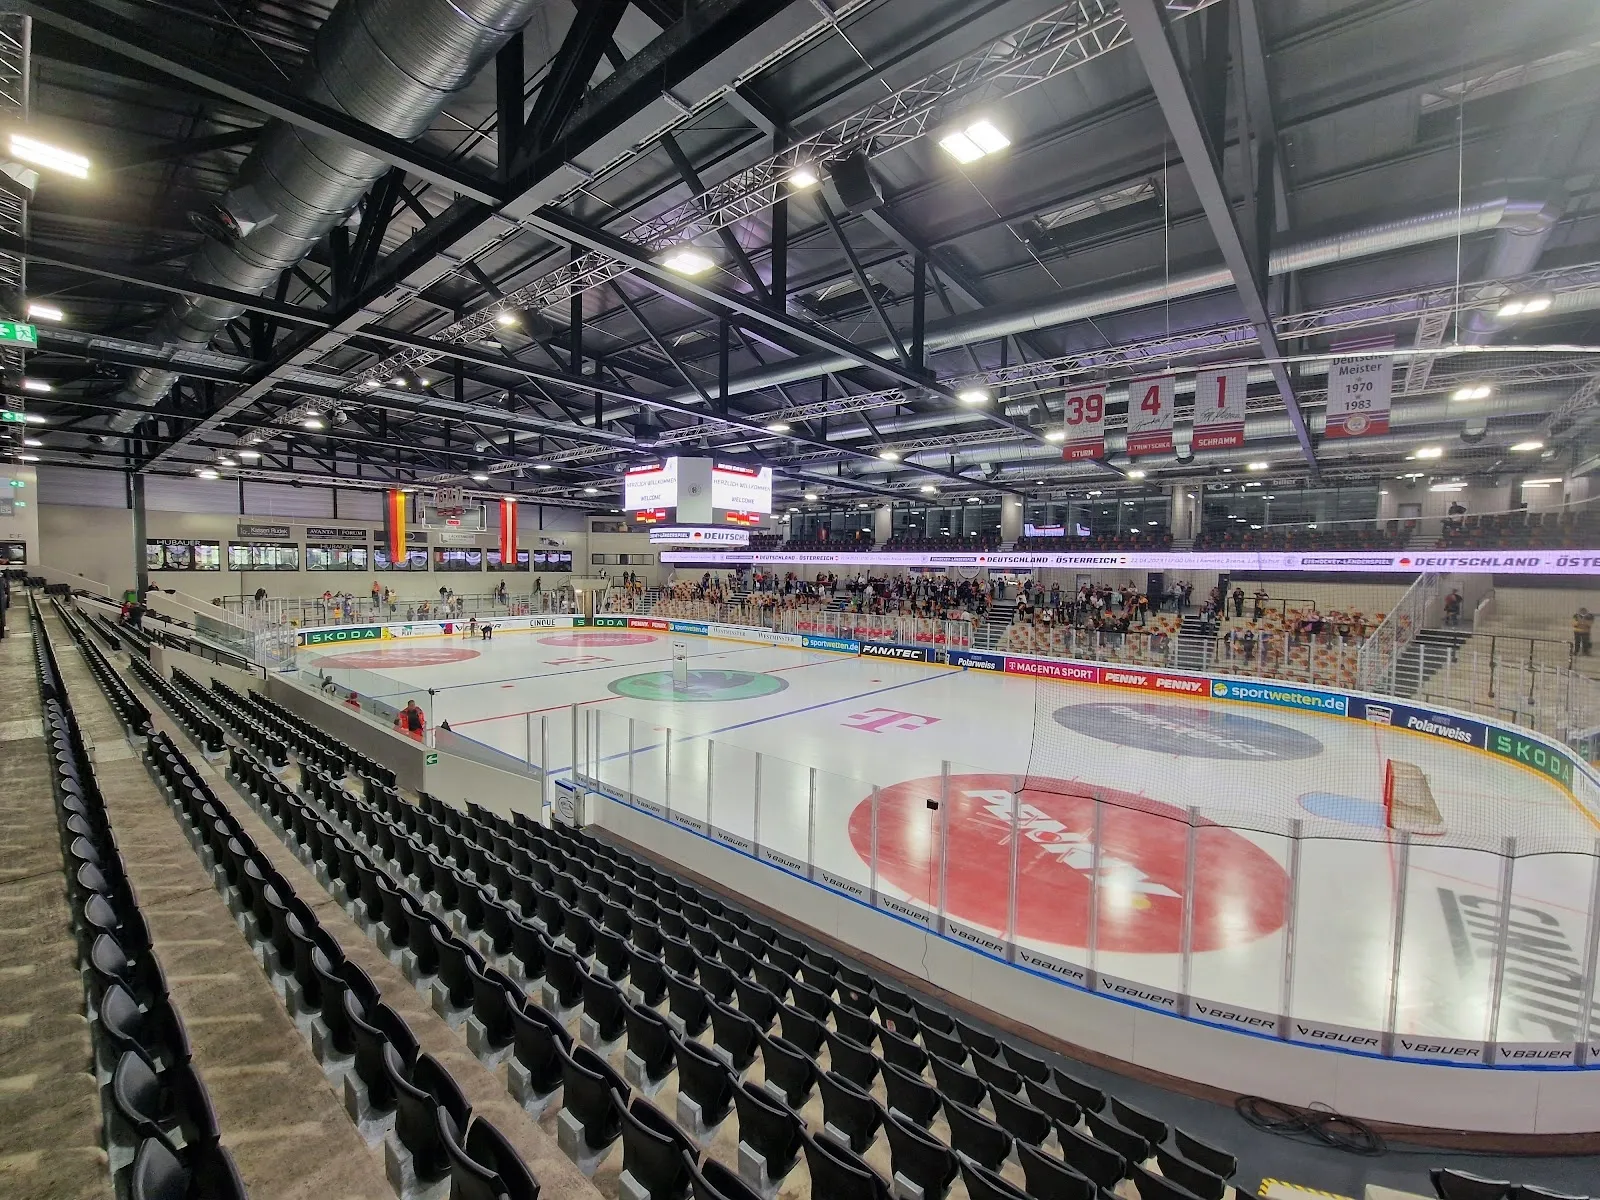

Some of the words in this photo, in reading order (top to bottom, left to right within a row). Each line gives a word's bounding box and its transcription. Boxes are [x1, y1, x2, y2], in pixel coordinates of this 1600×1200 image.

[1339, 363, 1383, 376] Meister
[1216, 376, 1227, 408] 1
[1346, 382, 1373, 393] 1970
[1140, 385, 1161, 415] 4
[1345, 400, 1372, 411] 1983
[1067, 394, 1103, 425] 39
[1198, 437, 1236, 446] SCHRAMM
[1072, 450, 1094, 458] STURM
[731, 496, 755, 504] WELCOME
[1055, 556, 1118, 564] ÖSTERREICH
[1414, 557, 1540, 567] DEUTSCHLAND
[529, 619, 555, 627] CINQUE
[675, 624, 708, 634] sportwetten.de
[810, 638, 859, 651] sportwetten.de
[863, 645, 920, 659] FANATEC
[957, 657, 996, 670] Polarweiss
[1017, 662, 1061, 676] MAGENTA
[1062, 667, 1094, 680] SPORT
[1232, 685, 1345, 711] sportwetten.de
[1407, 716, 1472, 743] Polarweiss
